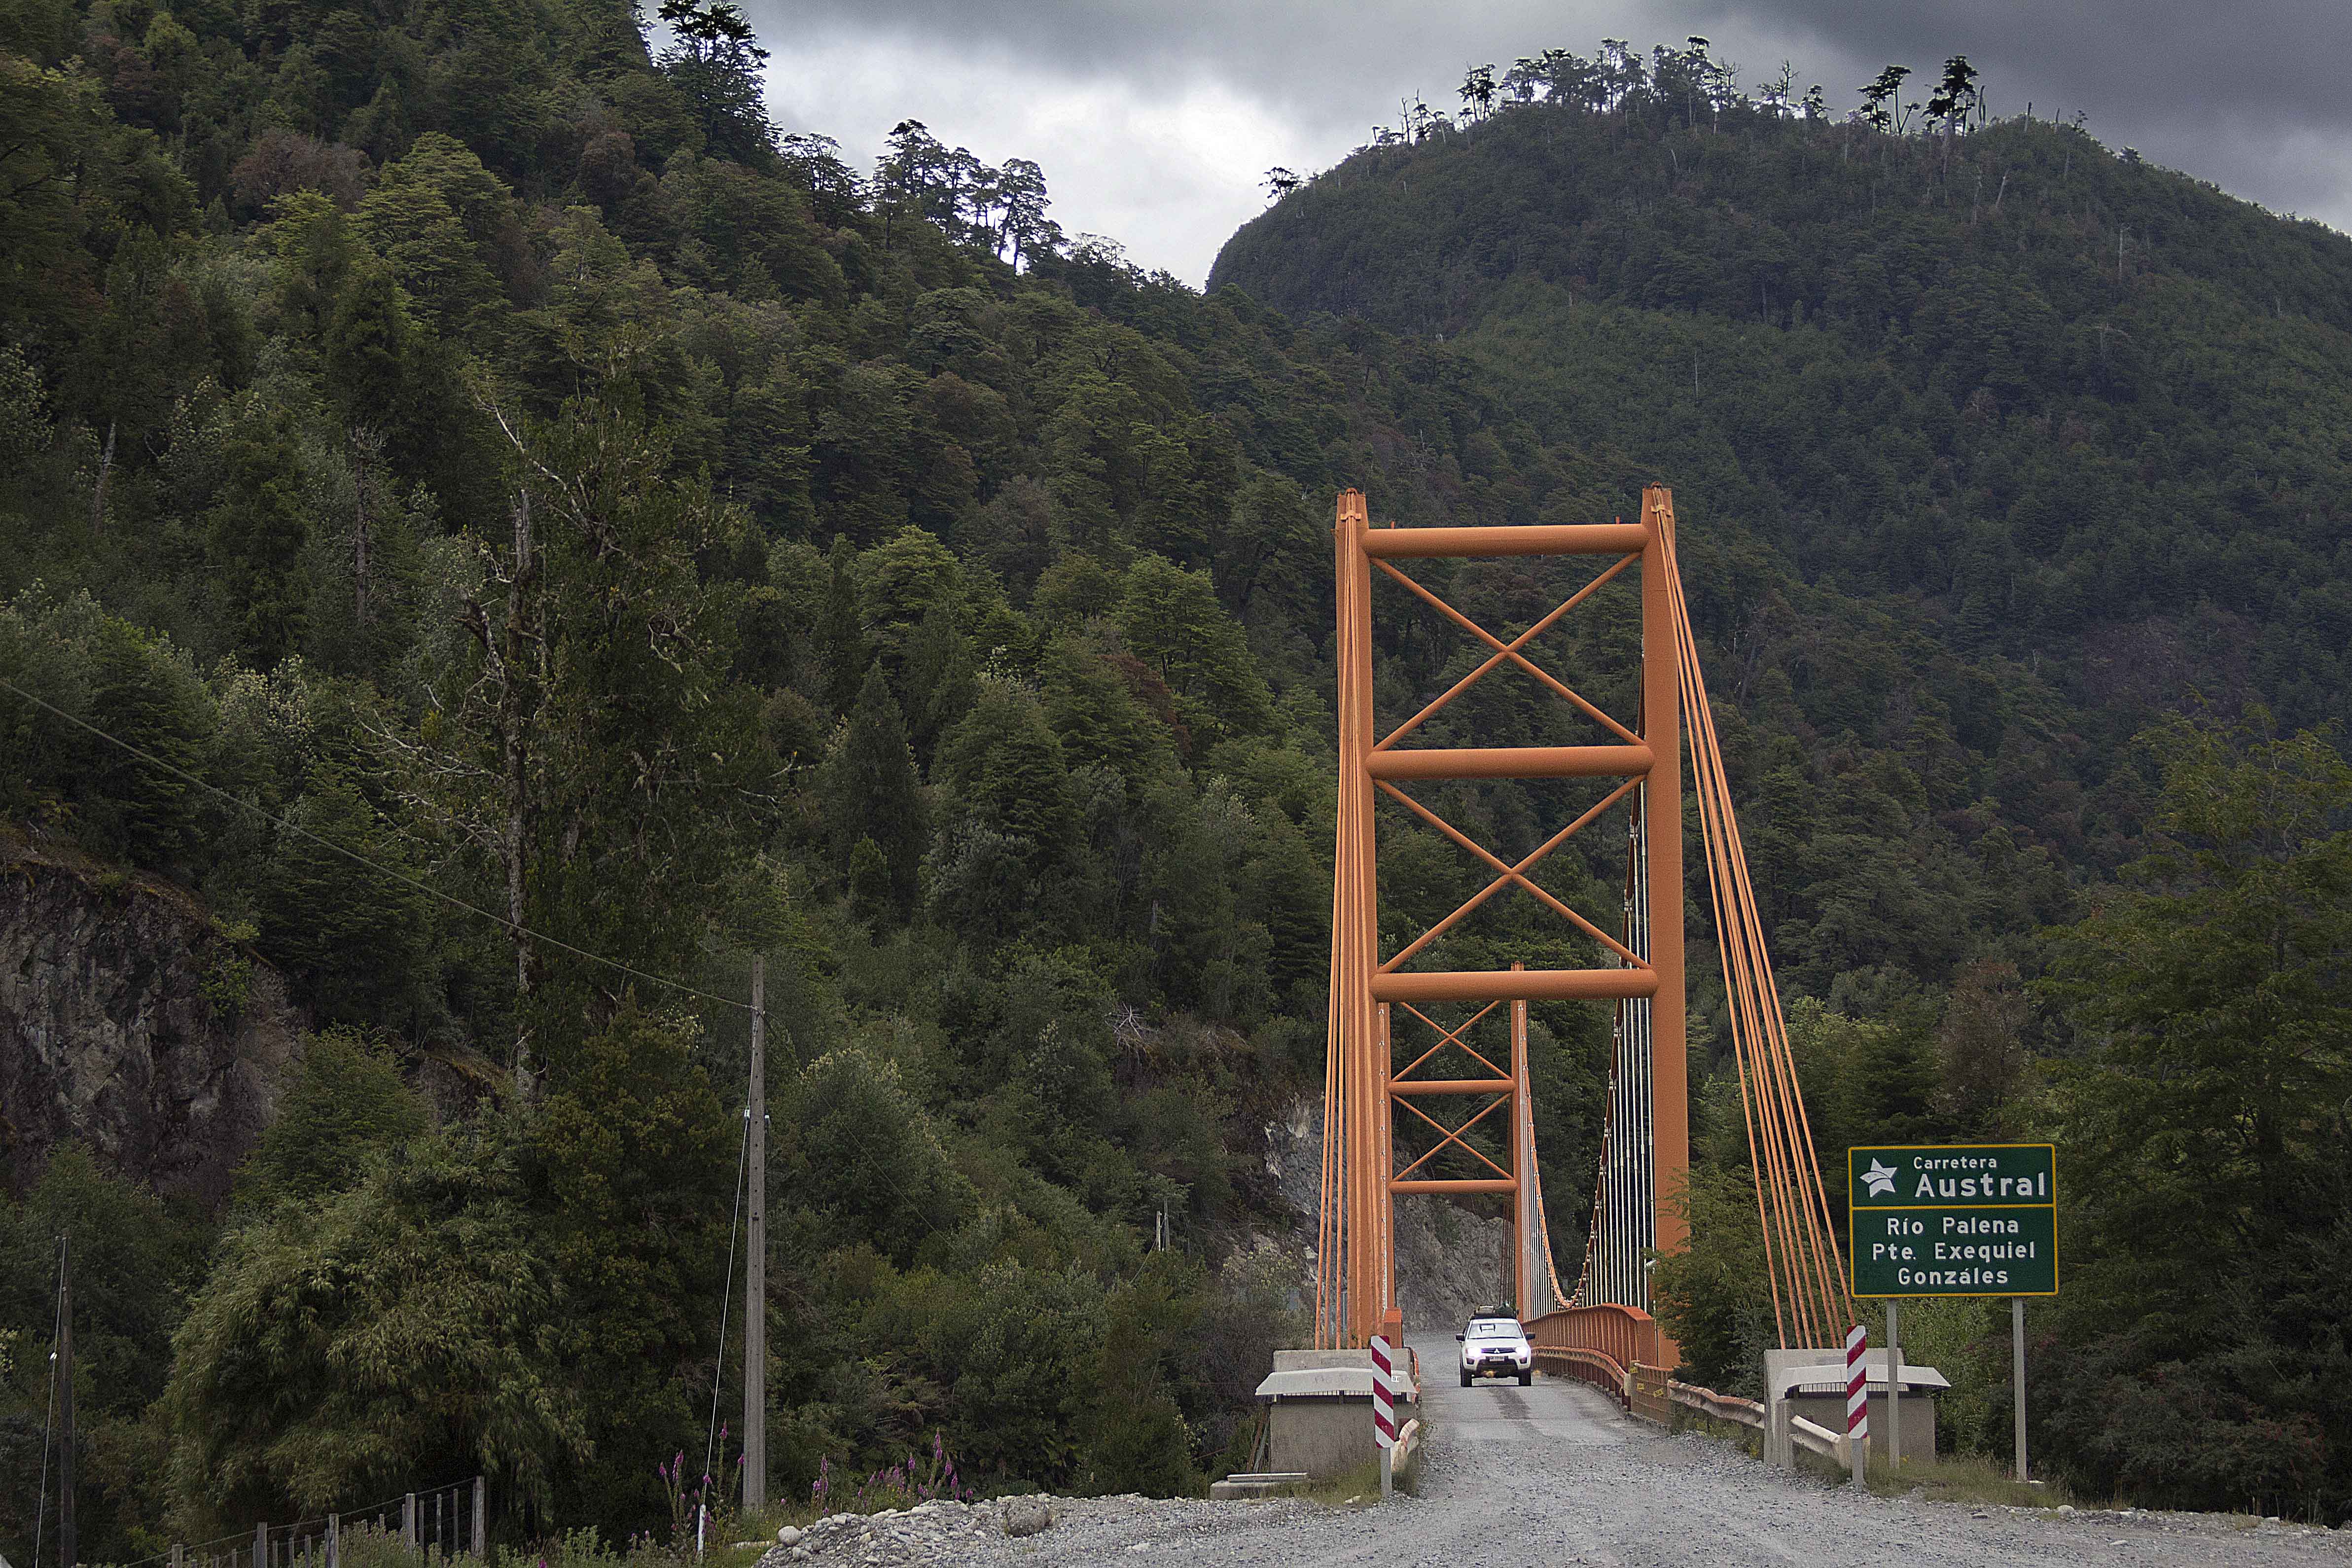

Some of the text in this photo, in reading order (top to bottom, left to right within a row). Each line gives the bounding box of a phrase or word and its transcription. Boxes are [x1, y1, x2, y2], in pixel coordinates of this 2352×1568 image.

[1913, 1156, 1997, 1170] Carretera
[1915, 1172, 2044, 1198] Austral
[1887, 1216, 2019, 1235] Río Palena
[1873, 1241, 2034, 1263] Pte. Exequiel
[1898, 1267, 2008, 1285] Gonzáles
